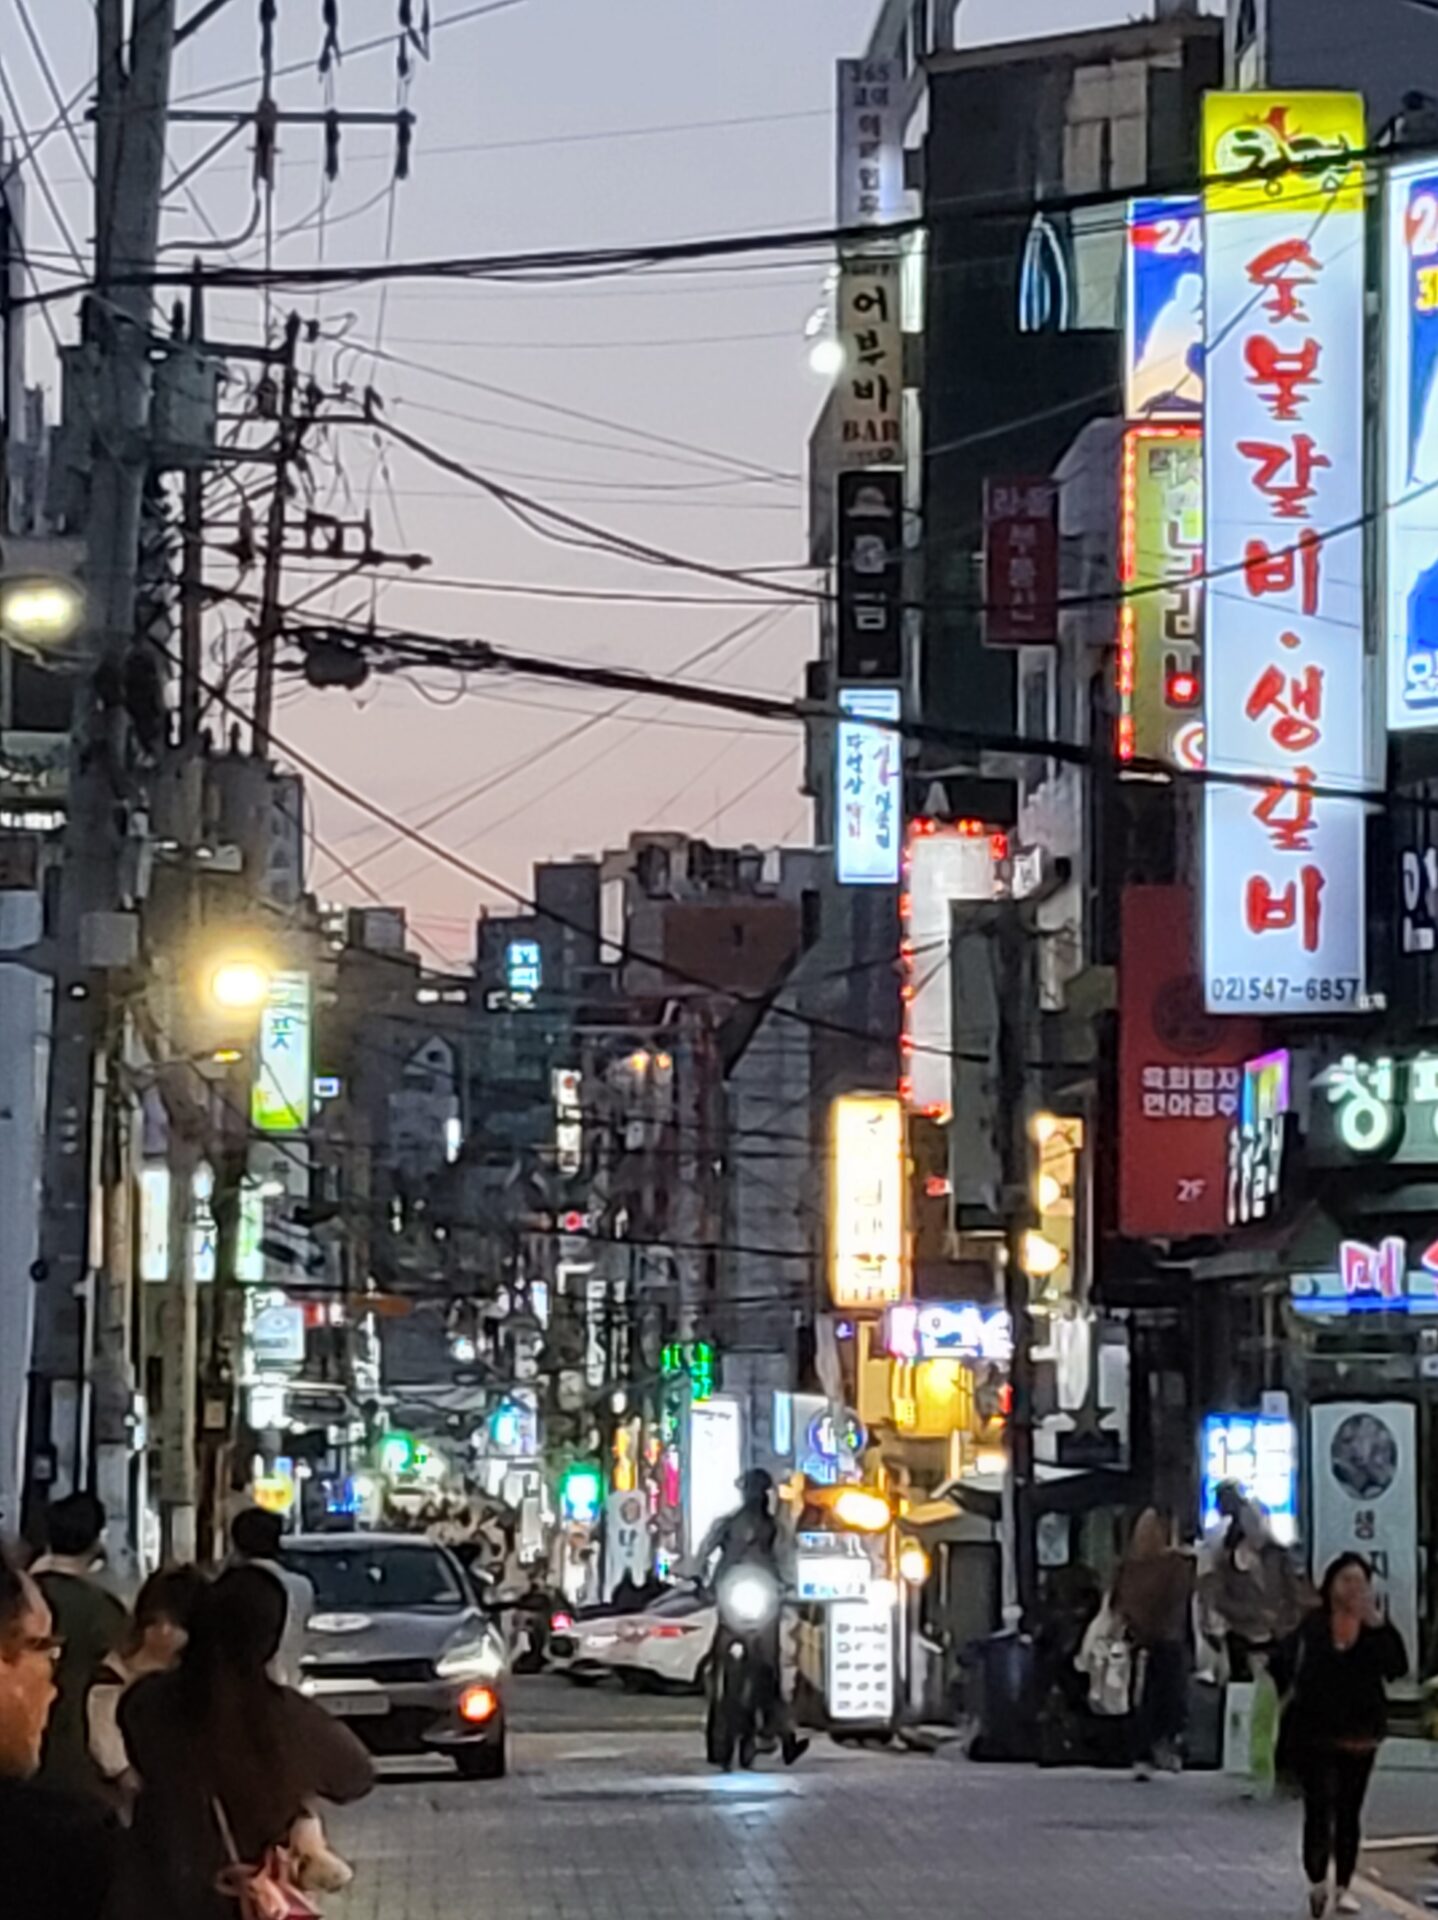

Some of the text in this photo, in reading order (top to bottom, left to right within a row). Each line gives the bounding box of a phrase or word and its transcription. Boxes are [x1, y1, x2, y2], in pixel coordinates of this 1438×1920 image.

[1153, 217, 1202, 254] 24
[842, 420, 899, 442] BAR
[1211, 976, 1361, 1001] 02)547-6857
[1177, 1178, 1206, 1201] 2F
